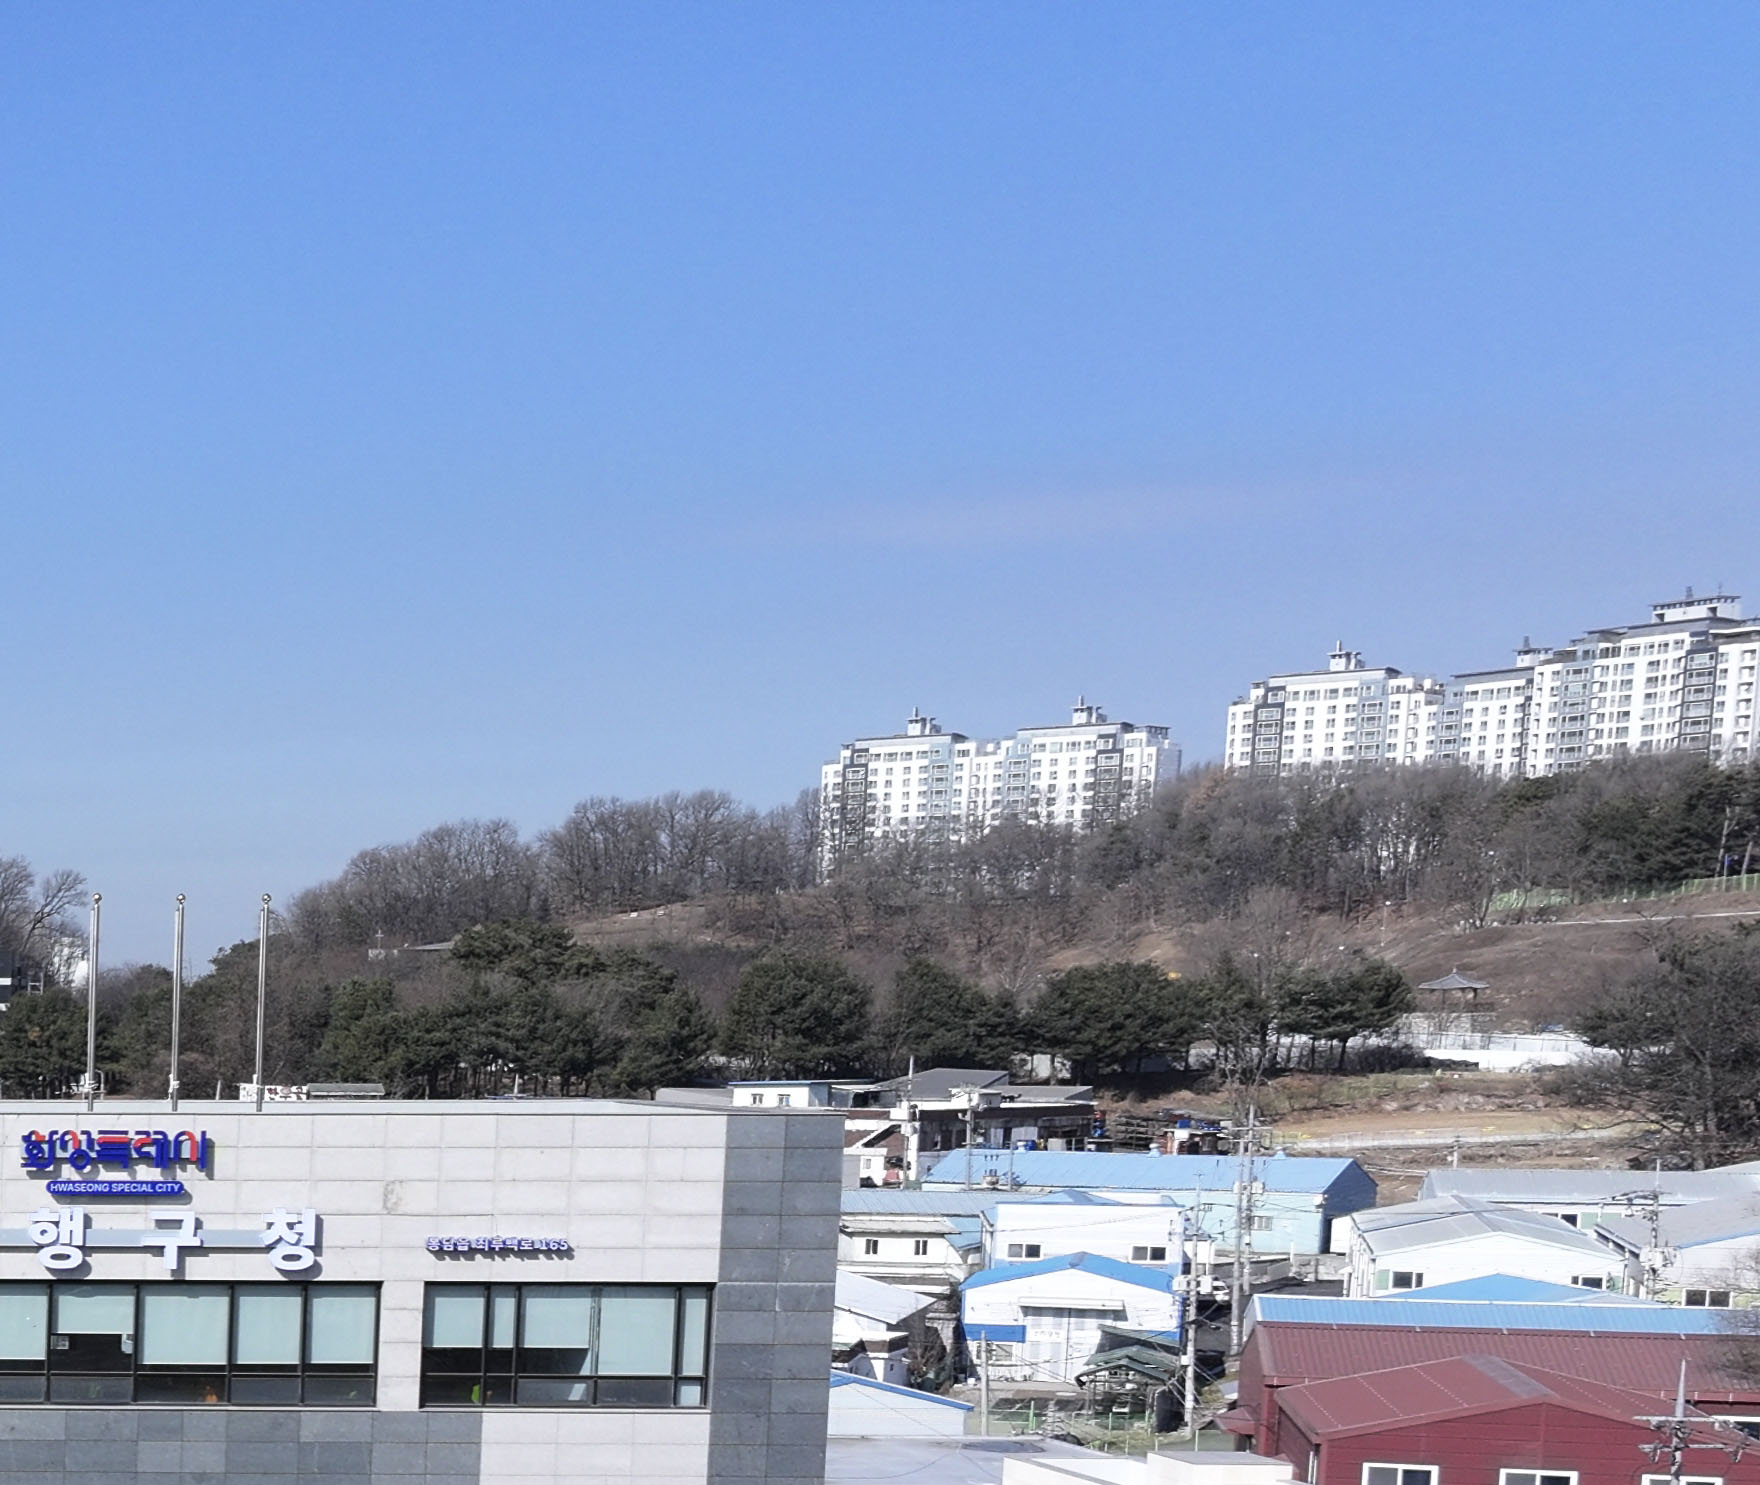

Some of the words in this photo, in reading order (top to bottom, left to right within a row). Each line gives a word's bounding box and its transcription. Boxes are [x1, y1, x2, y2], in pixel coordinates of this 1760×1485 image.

[20, 1129, 208, 1170] 화성특례시
[49, 1182, 110, 1194] HWASEONG
[110, 1182, 154, 1194] SPECIAL
[156, 1182, 181, 1194] CITY
[426, 1235, 470, 1251] 봉담읍
[539, 1238, 569, 1251] 165
